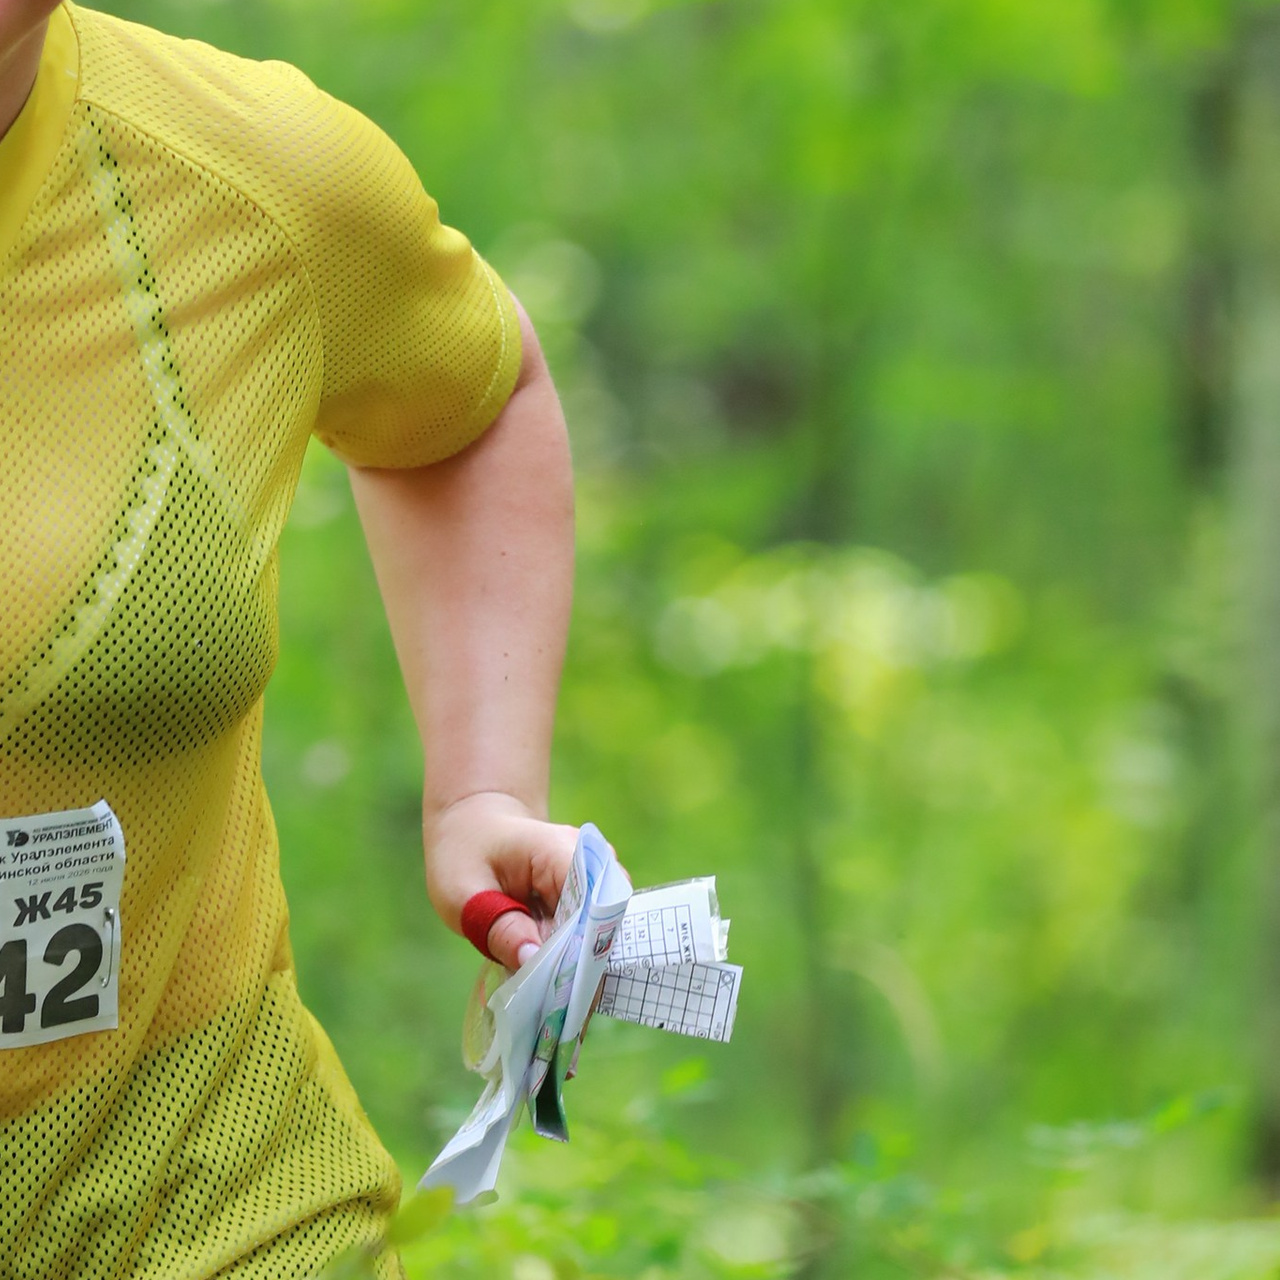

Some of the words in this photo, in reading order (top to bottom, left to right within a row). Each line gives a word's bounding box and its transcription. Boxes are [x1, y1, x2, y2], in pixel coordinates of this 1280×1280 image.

[32, 817, 114, 844] УРАЛЭЛЕМЕНТ
[11, 836, 115, 866] Уралэлемента
[54, 851, 115, 870] области
[12, 881, 104, 928] Ж45
